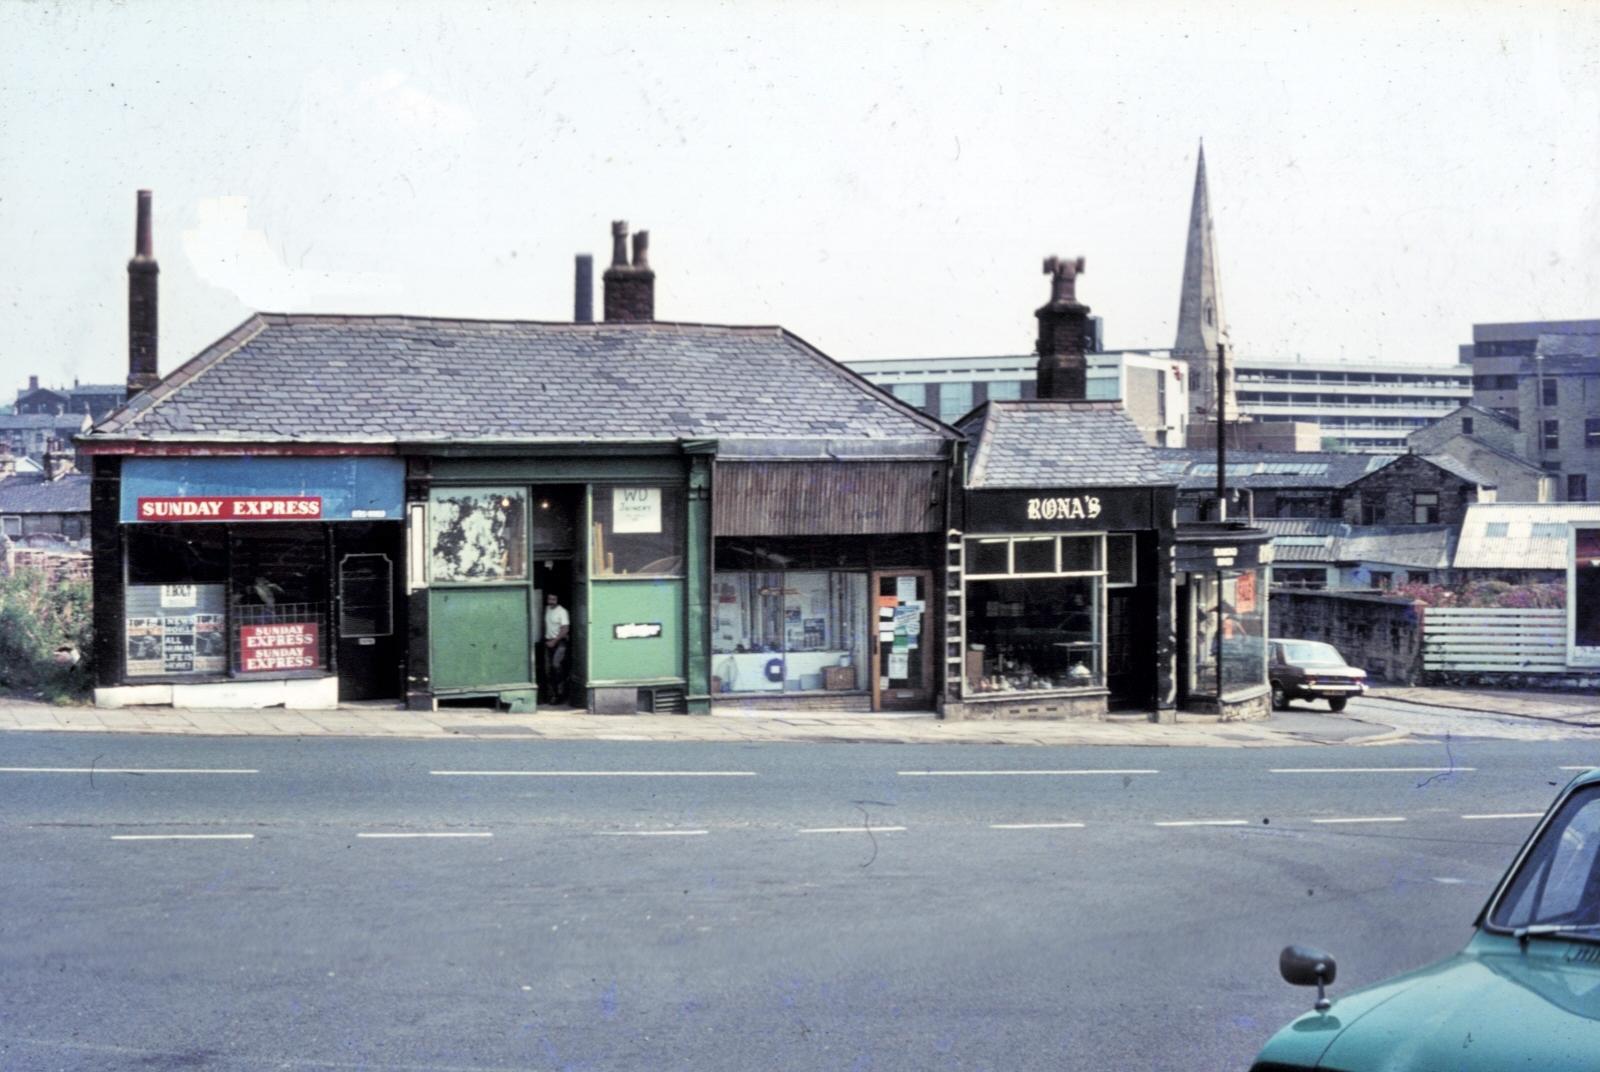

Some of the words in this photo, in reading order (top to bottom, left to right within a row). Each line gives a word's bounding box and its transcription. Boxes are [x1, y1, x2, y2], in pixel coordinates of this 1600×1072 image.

[142, 501, 223, 517] SUNDAY
[233, 500, 320, 516] EXPRESS
[1027, 496, 1102, 520] RONA'S
[255, 625, 305, 636] SUNDAY
[247, 633, 314, 648] EXPRESS
[255, 647, 305, 658] SUNDAY
[247, 656, 314, 670] EXPRESS
